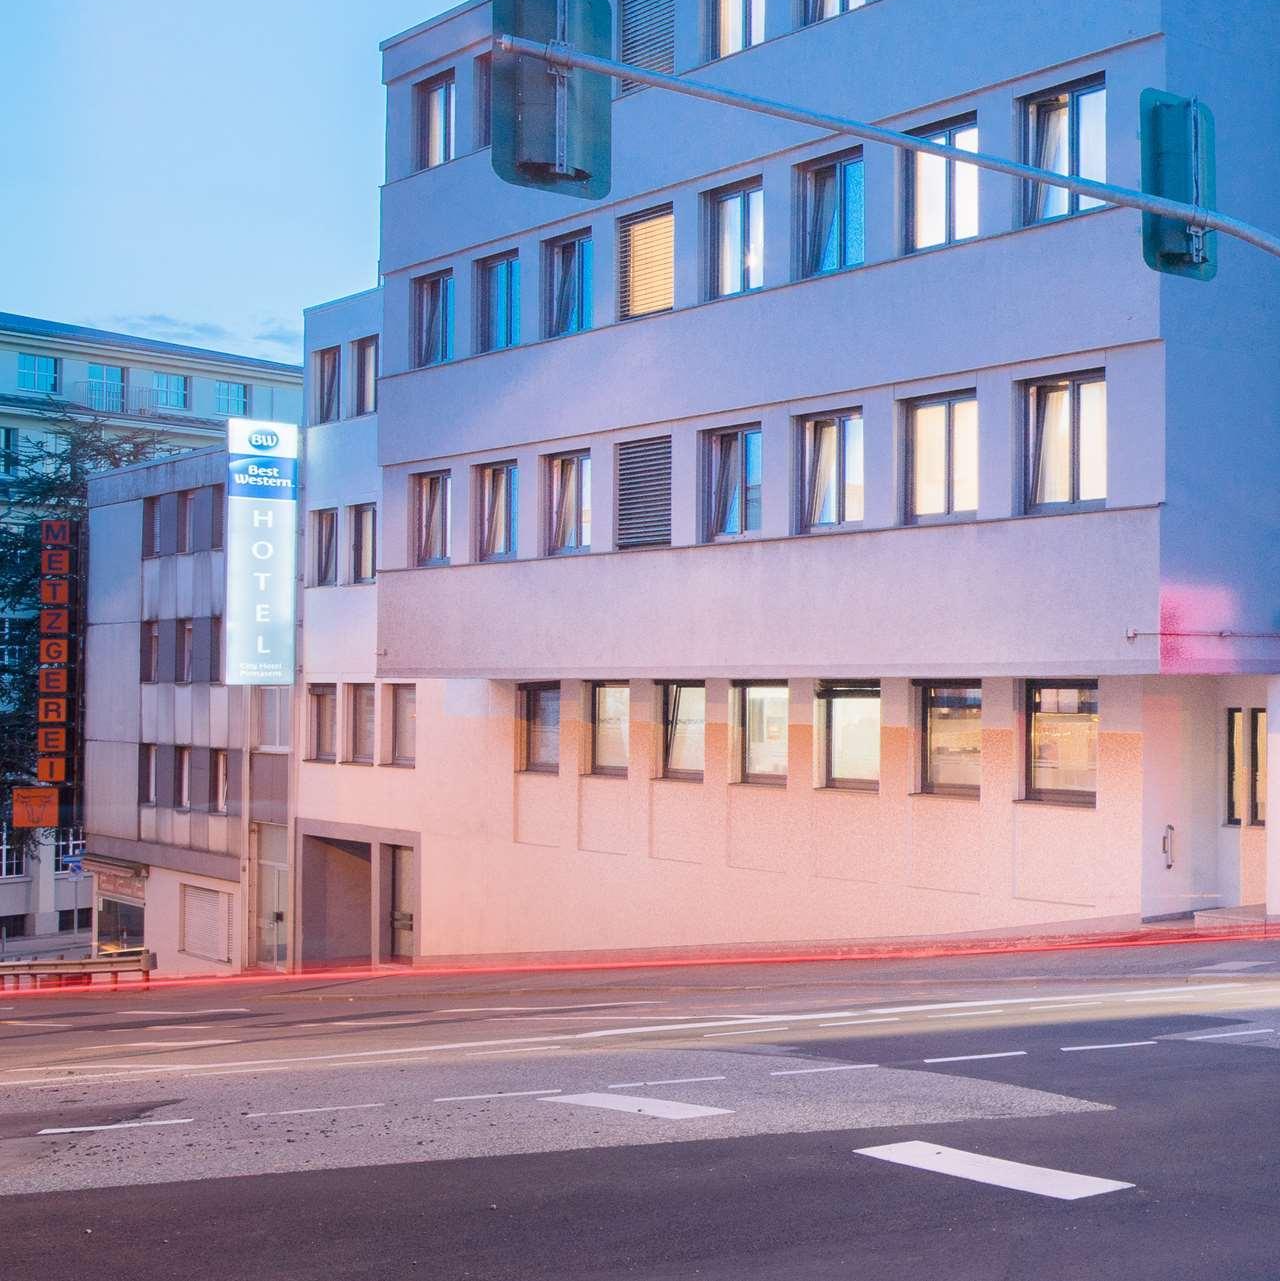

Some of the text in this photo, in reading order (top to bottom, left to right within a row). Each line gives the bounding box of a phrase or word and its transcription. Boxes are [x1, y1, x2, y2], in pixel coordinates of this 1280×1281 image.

[248, 464, 280, 478] Best
[251, 433, 277, 447] BW
[251, 509, 274, 654] HOTEL
[44, 524, 66, 777] METZGEREI
